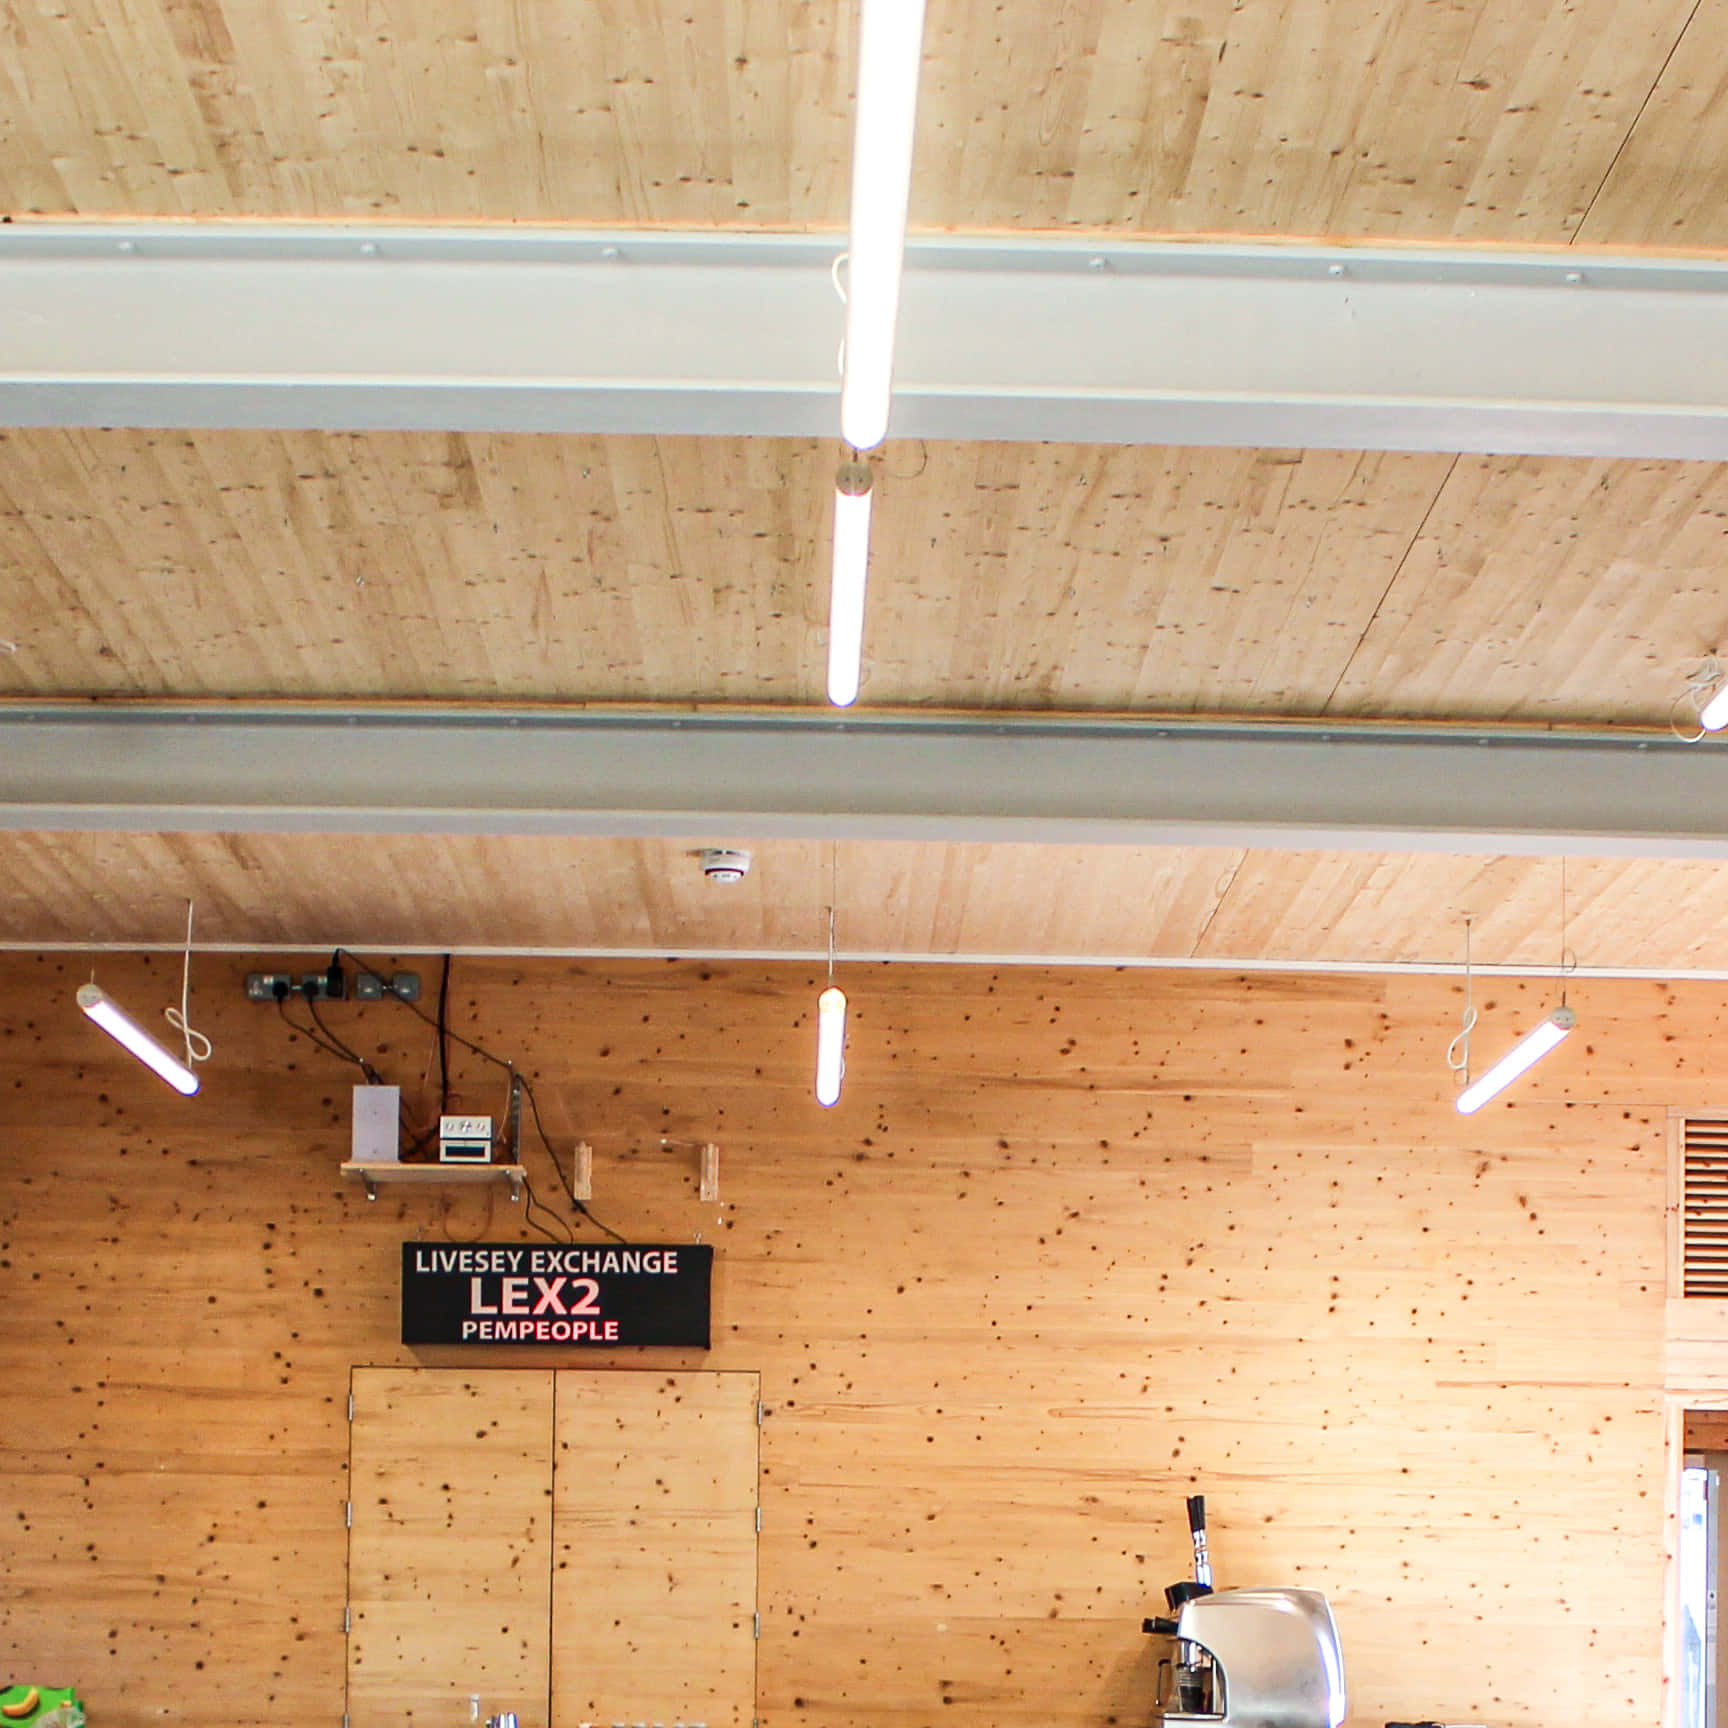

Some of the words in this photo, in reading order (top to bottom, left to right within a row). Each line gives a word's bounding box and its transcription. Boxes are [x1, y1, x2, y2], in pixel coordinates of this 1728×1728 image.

[416, 1250, 522, 1272] LIVESEY
[530, 1250, 678, 1274] EXCHANGE
[470, 1276, 601, 1315] LEX2
[462, 1321, 619, 1340] PEMPEOPLE
